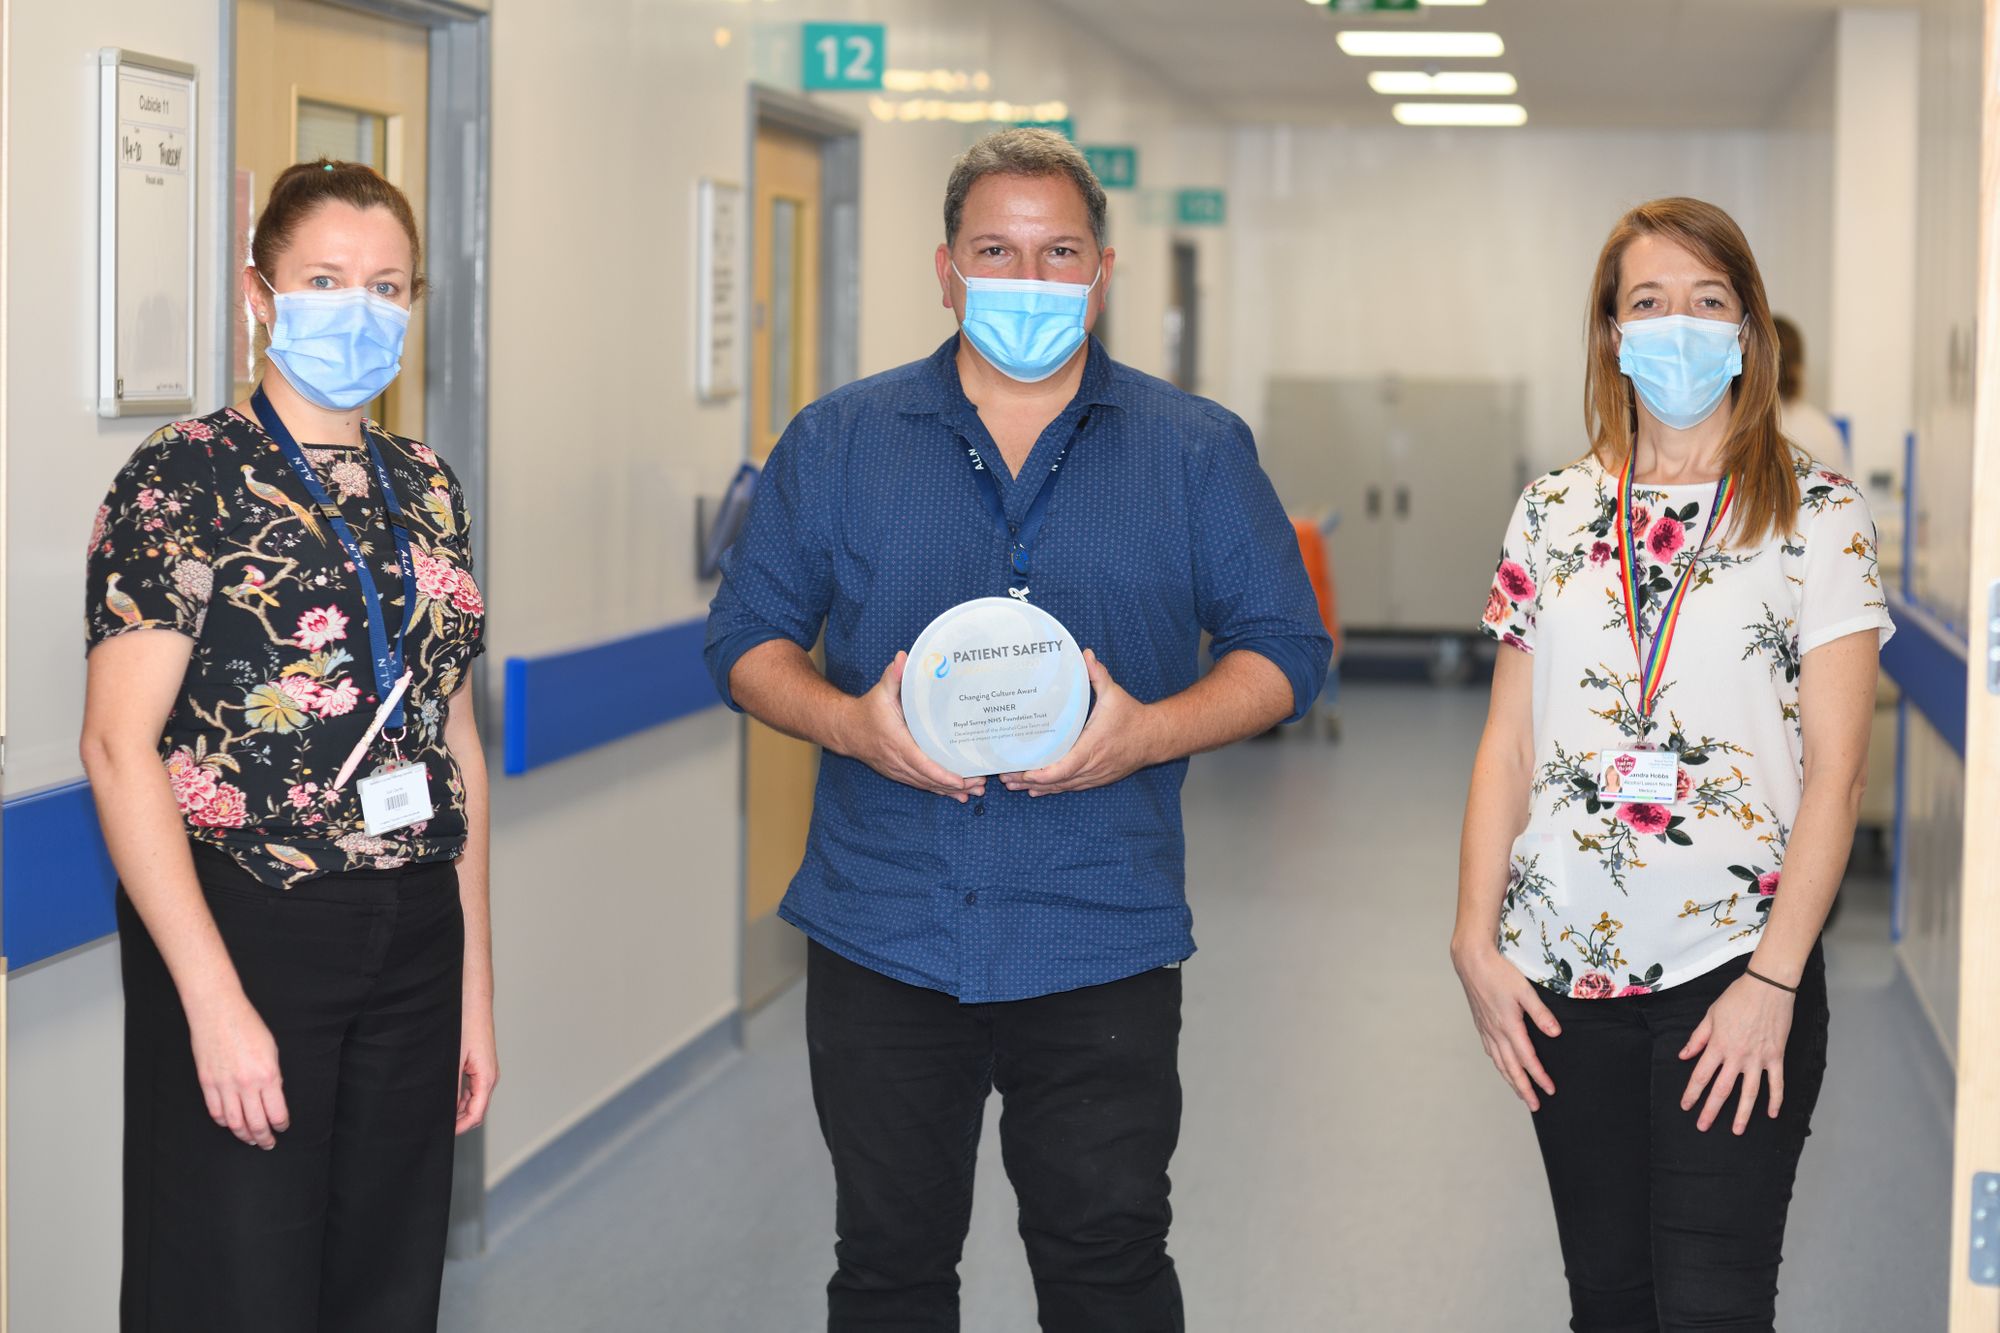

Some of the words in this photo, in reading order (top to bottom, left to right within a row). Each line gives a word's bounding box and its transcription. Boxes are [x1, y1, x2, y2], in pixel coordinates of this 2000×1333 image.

[815, 36, 876, 79] 12
[139, 95, 161, 113] Cubicle
[162, 99, 169, 115] 11
[953, 646, 1009, 663] PATIENT
[1012, 640, 1063, 656] SAFETY
[959, 693, 990, 702] Changing
[991, 690, 1016, 698] Culture
[1017, 687, 1037, 695] Award
[983, 703, 1016, 713] WINNER
[969, 719, 987, 727] Surrey
[1003, 714, 1033, 722] Foundation
